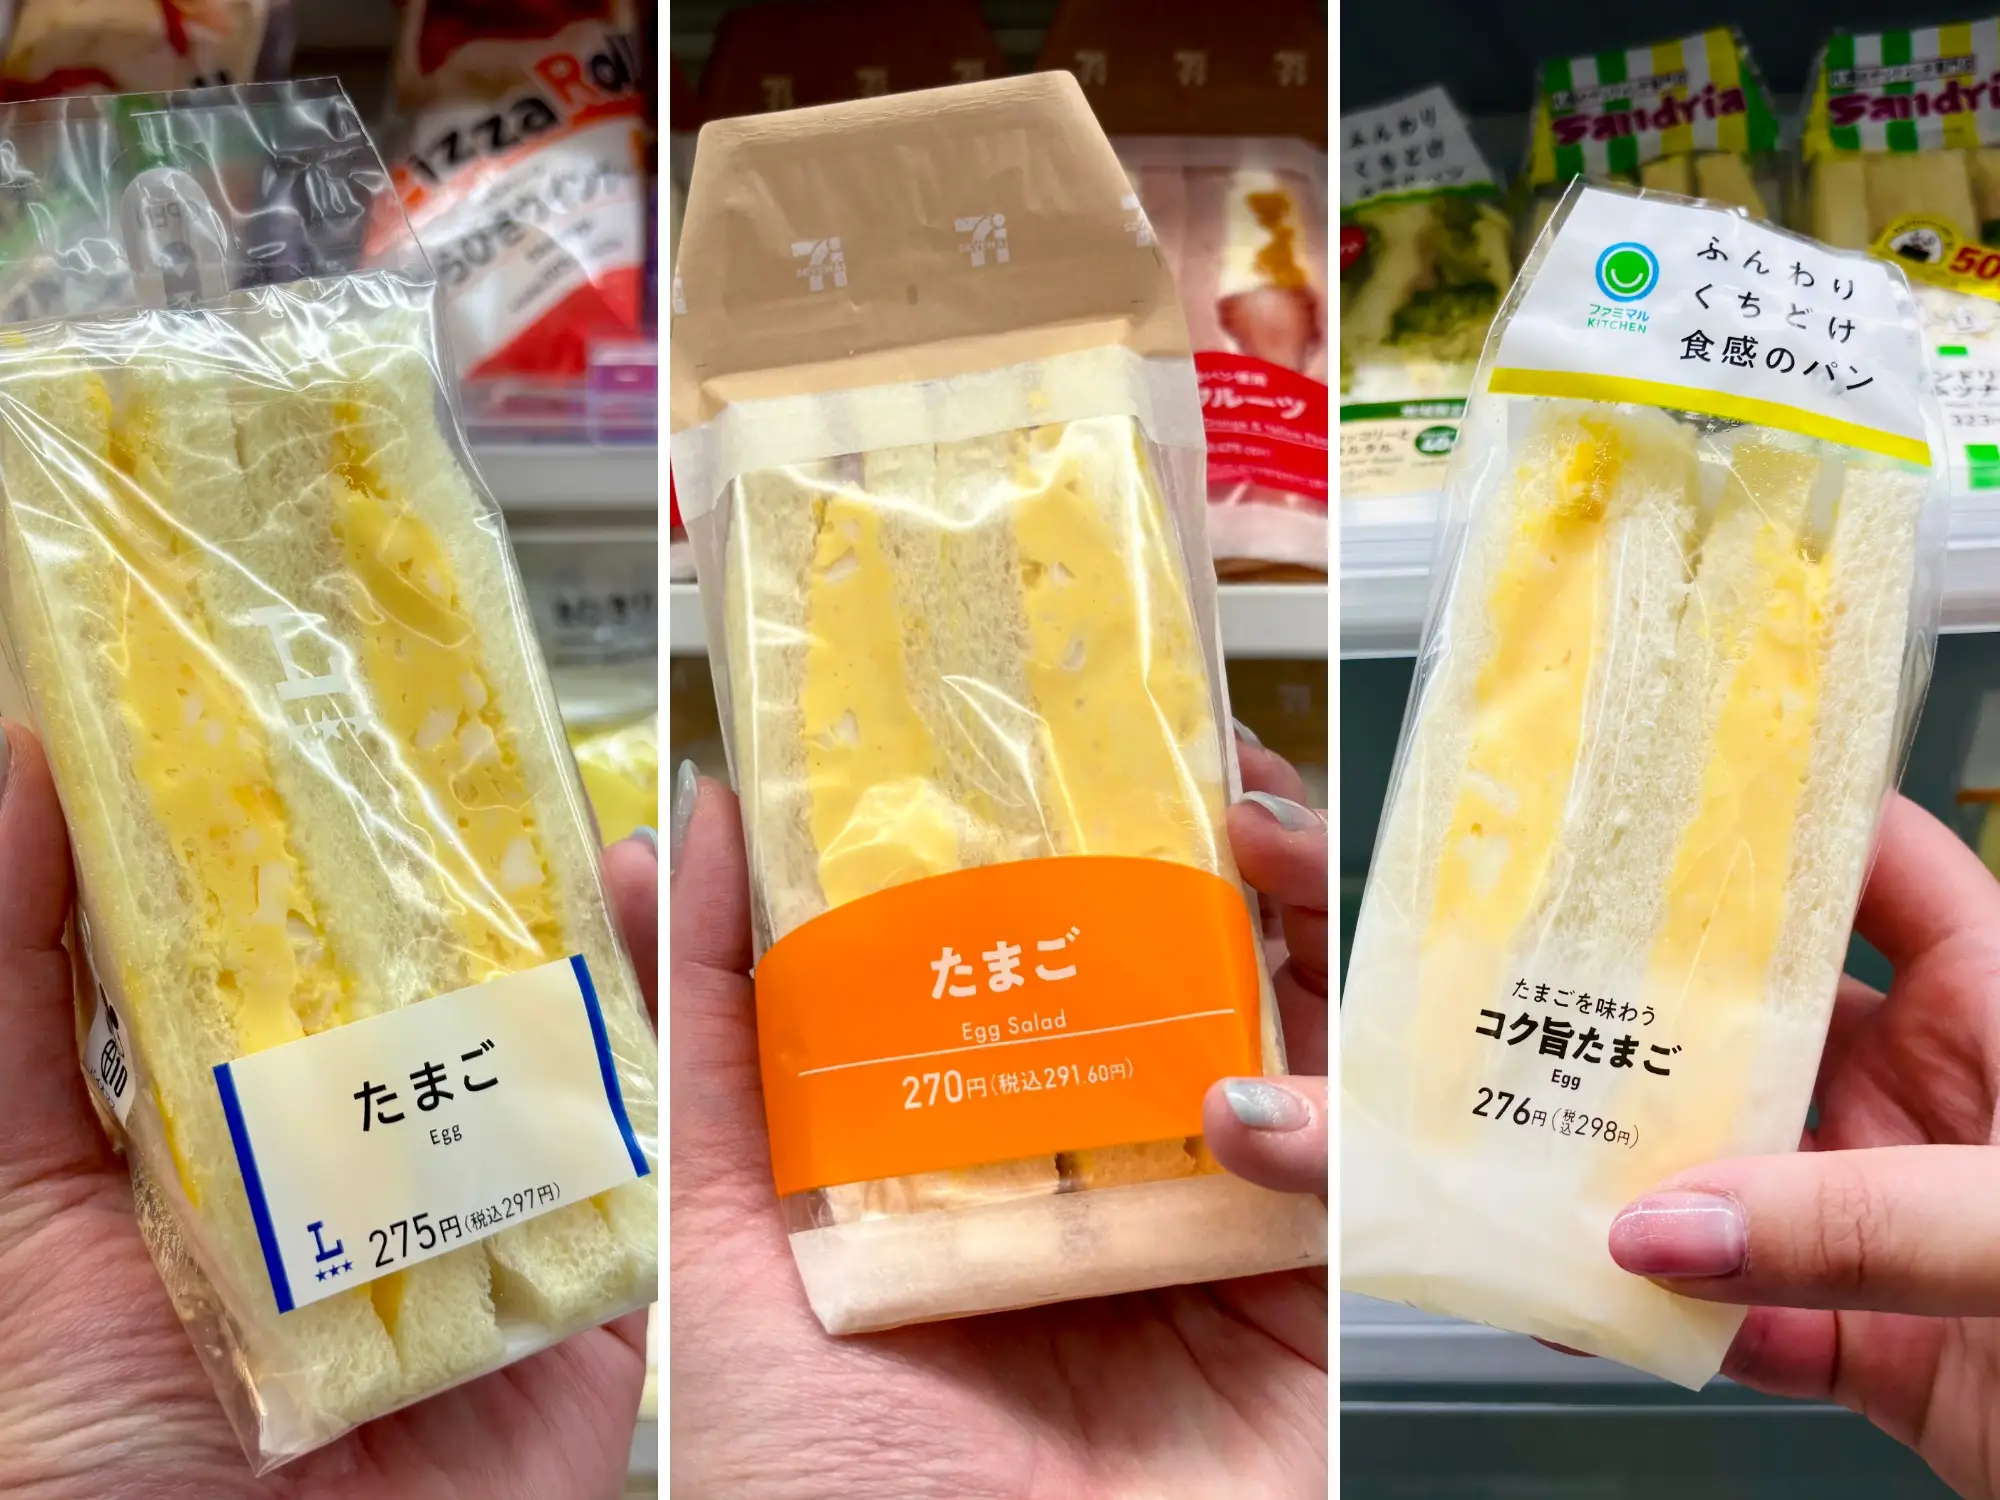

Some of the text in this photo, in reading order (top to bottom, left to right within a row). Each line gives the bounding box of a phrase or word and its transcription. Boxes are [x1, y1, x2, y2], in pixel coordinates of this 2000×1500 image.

[1552, 83, 1747, 146] Sandria
[1697, 237, 1854, 300] ふんわり
[1587, 318, 1647, 334] KITCHEN
[1589, 304, 1649, 322] ファミマル
[1695, 284, 1855, 344] くちどけ
[1680, 329, 1874, 391] 食感のパン
[931, 926, 1081, 999] たまご
[962, 1009, 1067, 1044] Egg Salad
[1512, 978, 1656, 1026] たまごを味わう
[1475, 1009, 1682, 1076] コク旨たまご
[354, 1038, 499, 1132] たまご
[1551, 1069, 1581, 1090] Egg
[429, 1124, 462, 1145] Egg
